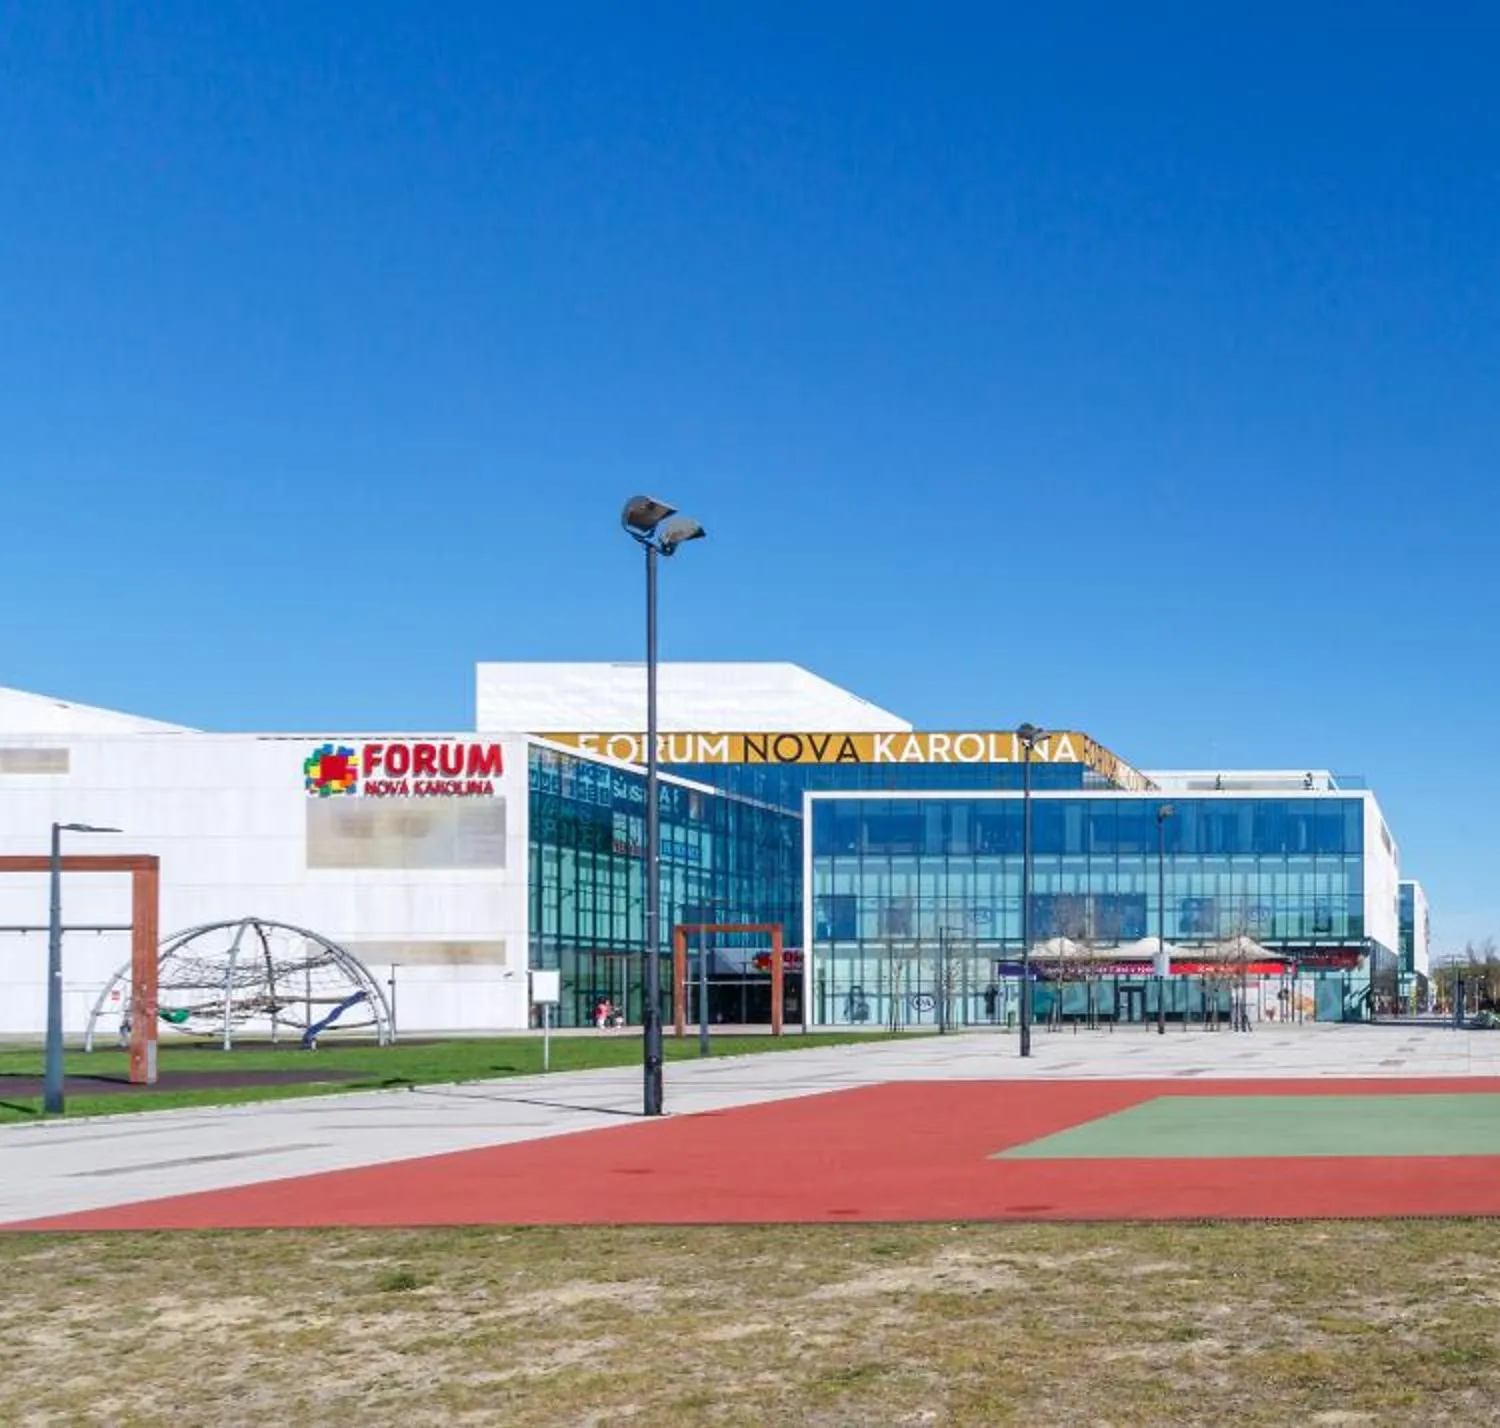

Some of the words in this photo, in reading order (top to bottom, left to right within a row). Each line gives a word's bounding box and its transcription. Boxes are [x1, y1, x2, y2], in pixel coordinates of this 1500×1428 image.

[363, 743, 504, 778] FORUM
[578, 733, 728, 763] FORUM
[743, 733, 861, 763] NOVA
[873, 733, 1079, 763] KAROLINA
[363, 779, 410, 796] NOVÁ
[413, 780, 494, 797] KAROLINA
